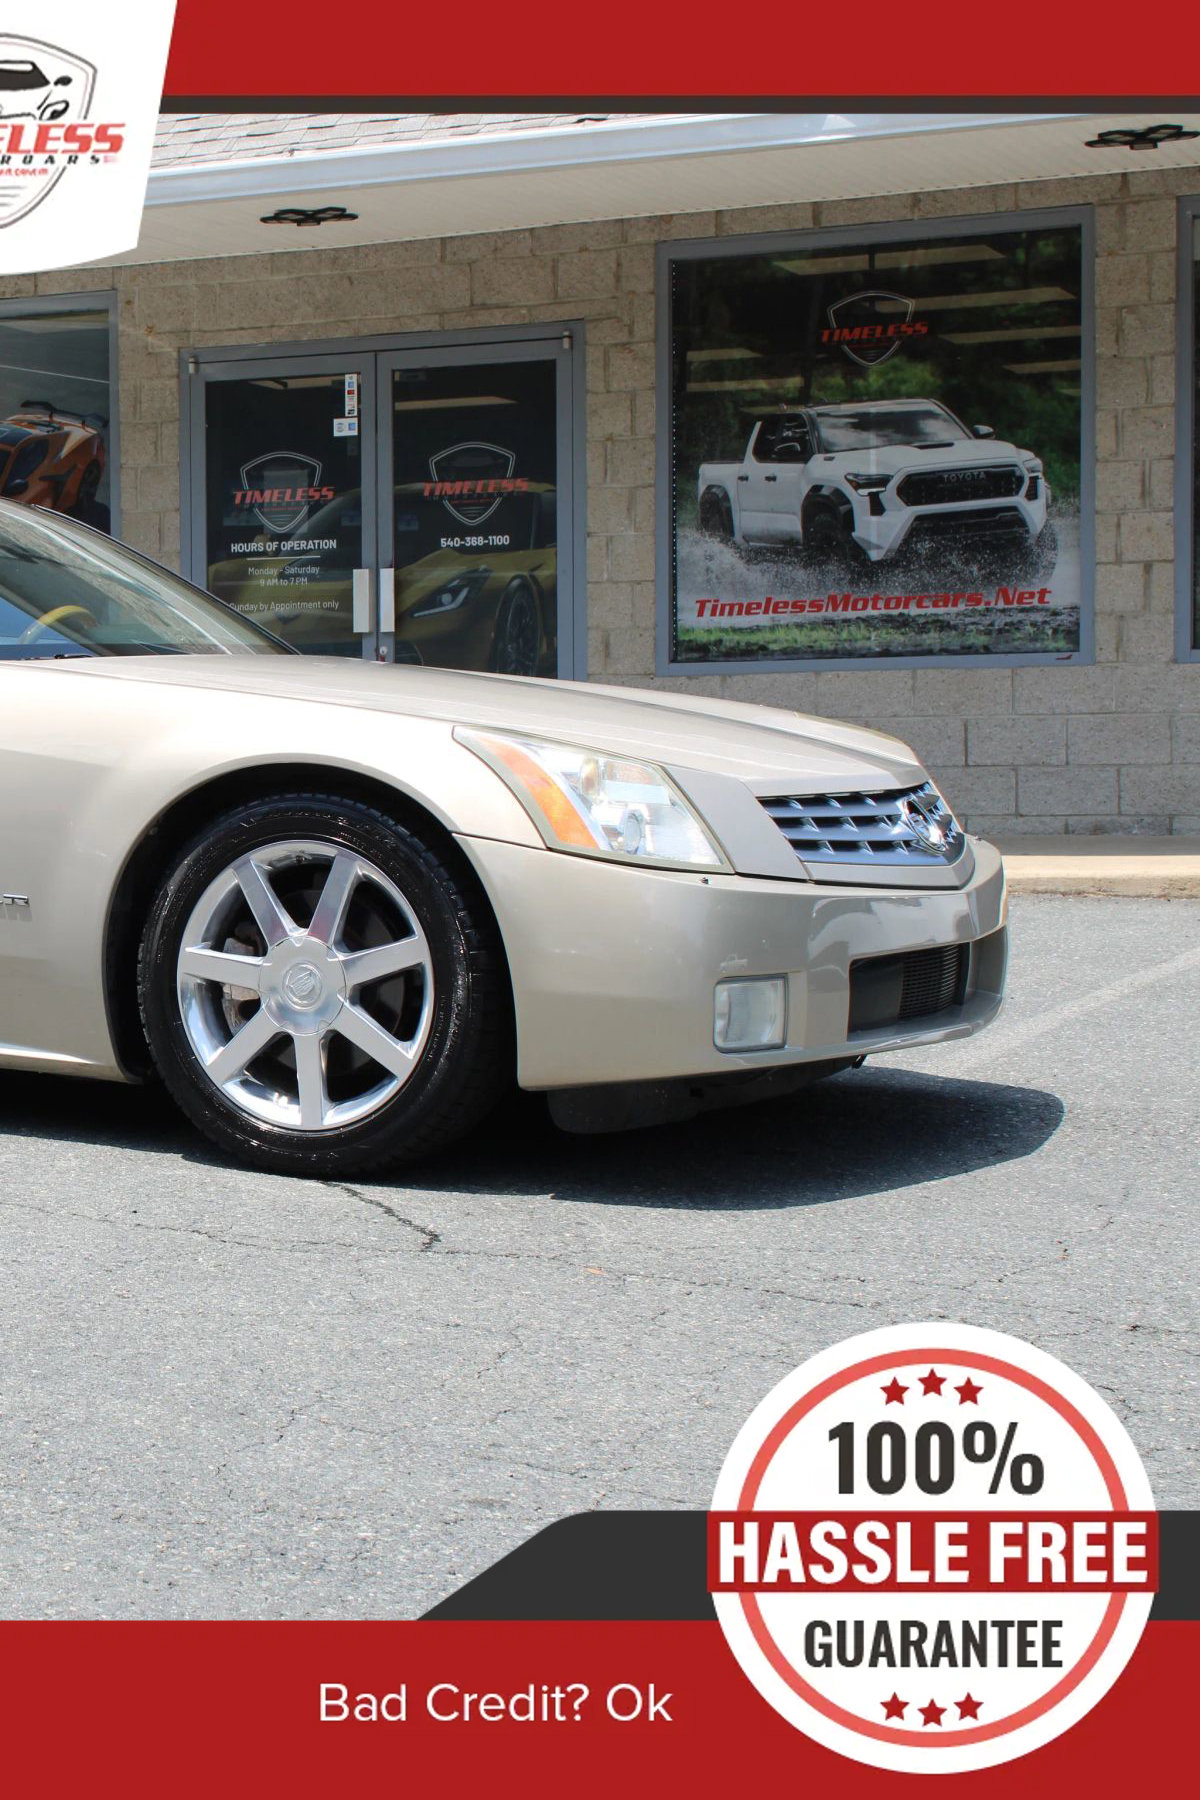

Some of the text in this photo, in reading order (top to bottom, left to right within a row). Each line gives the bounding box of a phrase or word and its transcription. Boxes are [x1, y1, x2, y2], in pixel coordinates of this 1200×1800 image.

[821, 321, 929, 343] TIMELESS
[943, 471, 986, 482] TOYOTA
[422, 478, 529, 496] TIMELESS
[233, 487, 335, 505] TIMELESS
[231, 539, 337, 553] HOURS OF OPERATION
[440, 535, 510, 548] 540-368-1100
[248, 566, 278, 577] Monday
[284, 565, 320, 575] Saturday
[260, 577, 308, 587] 9 AM to 7 PM
[259, 601, 269, 612] by
[270, 600, 321, 611] Appointment
[322, 599, 340, 610] only
[695, 587, 1052, 618] TimelessMotorcars.Net
